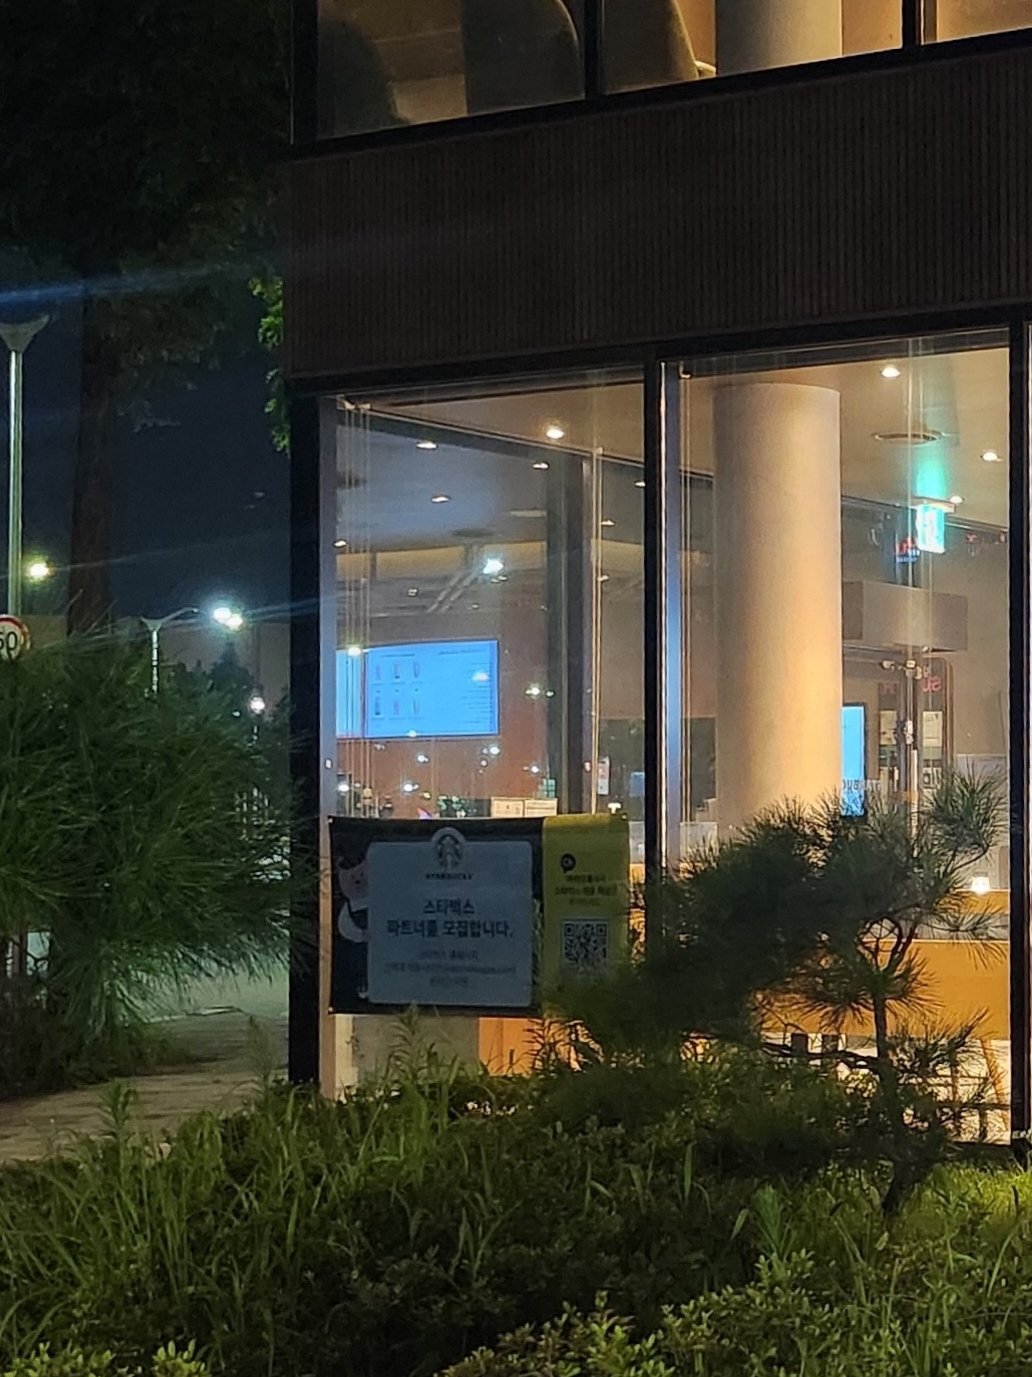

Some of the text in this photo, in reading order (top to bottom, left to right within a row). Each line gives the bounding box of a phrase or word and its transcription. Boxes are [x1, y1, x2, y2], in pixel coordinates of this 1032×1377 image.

[423, 899, 475, 915] 스타벅스
[386, 919, 513, 938] 파트너를 모집합니다.
